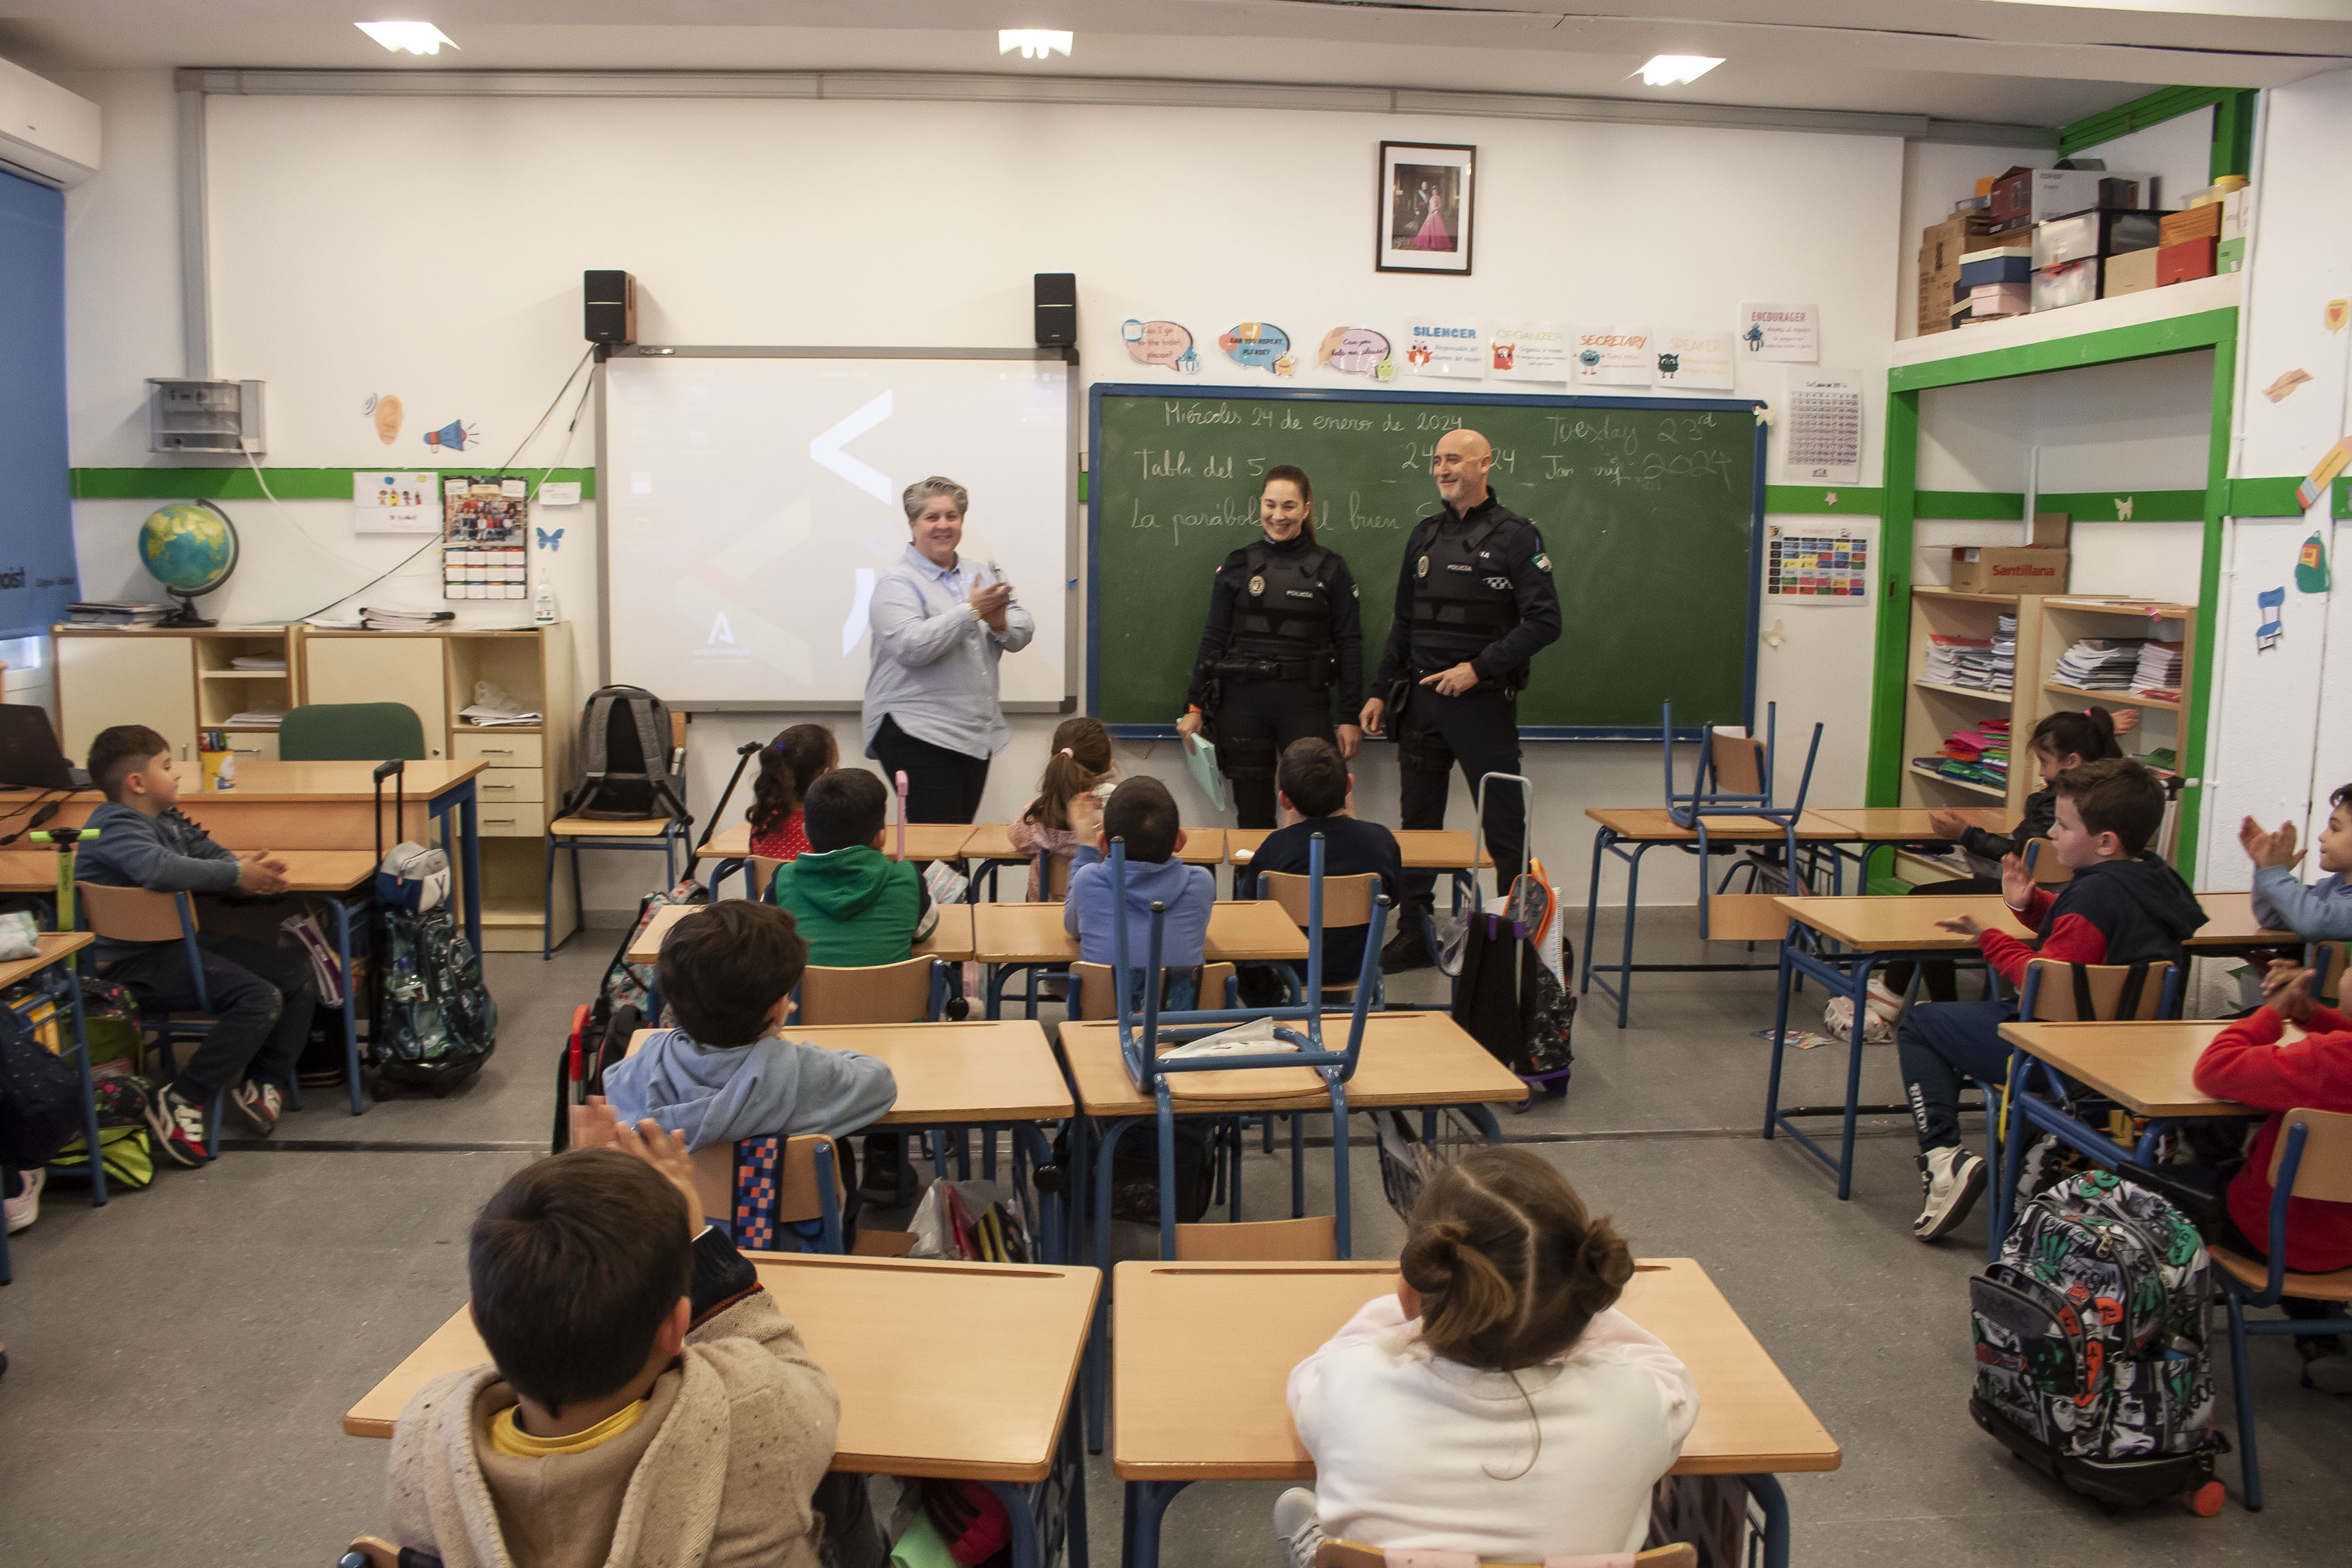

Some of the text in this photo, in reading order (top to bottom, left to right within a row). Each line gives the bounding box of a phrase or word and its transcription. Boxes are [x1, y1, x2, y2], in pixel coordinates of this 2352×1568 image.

[1751, 311, 1806, 322] ENCOURAGER
[1413, 327, 1476, 339] SILENCER
[1577, 334, 1647, 351] SECRETARY
[1669, 337, 1721, 353] SPEAKER
[1164, 401, 1462, 433] Miércoles 24 de enero de 2024
[1545, 415, 1639, 454] Tuesday
[1132, 447, 1267, 480] Tabla del 5
[1640, 449, 1733, 492] 2024
[1131, 497, 1160, 529] La
[1350, 491, 1402, 530] buen
[1992, 564, 2055, 577] Santillana
